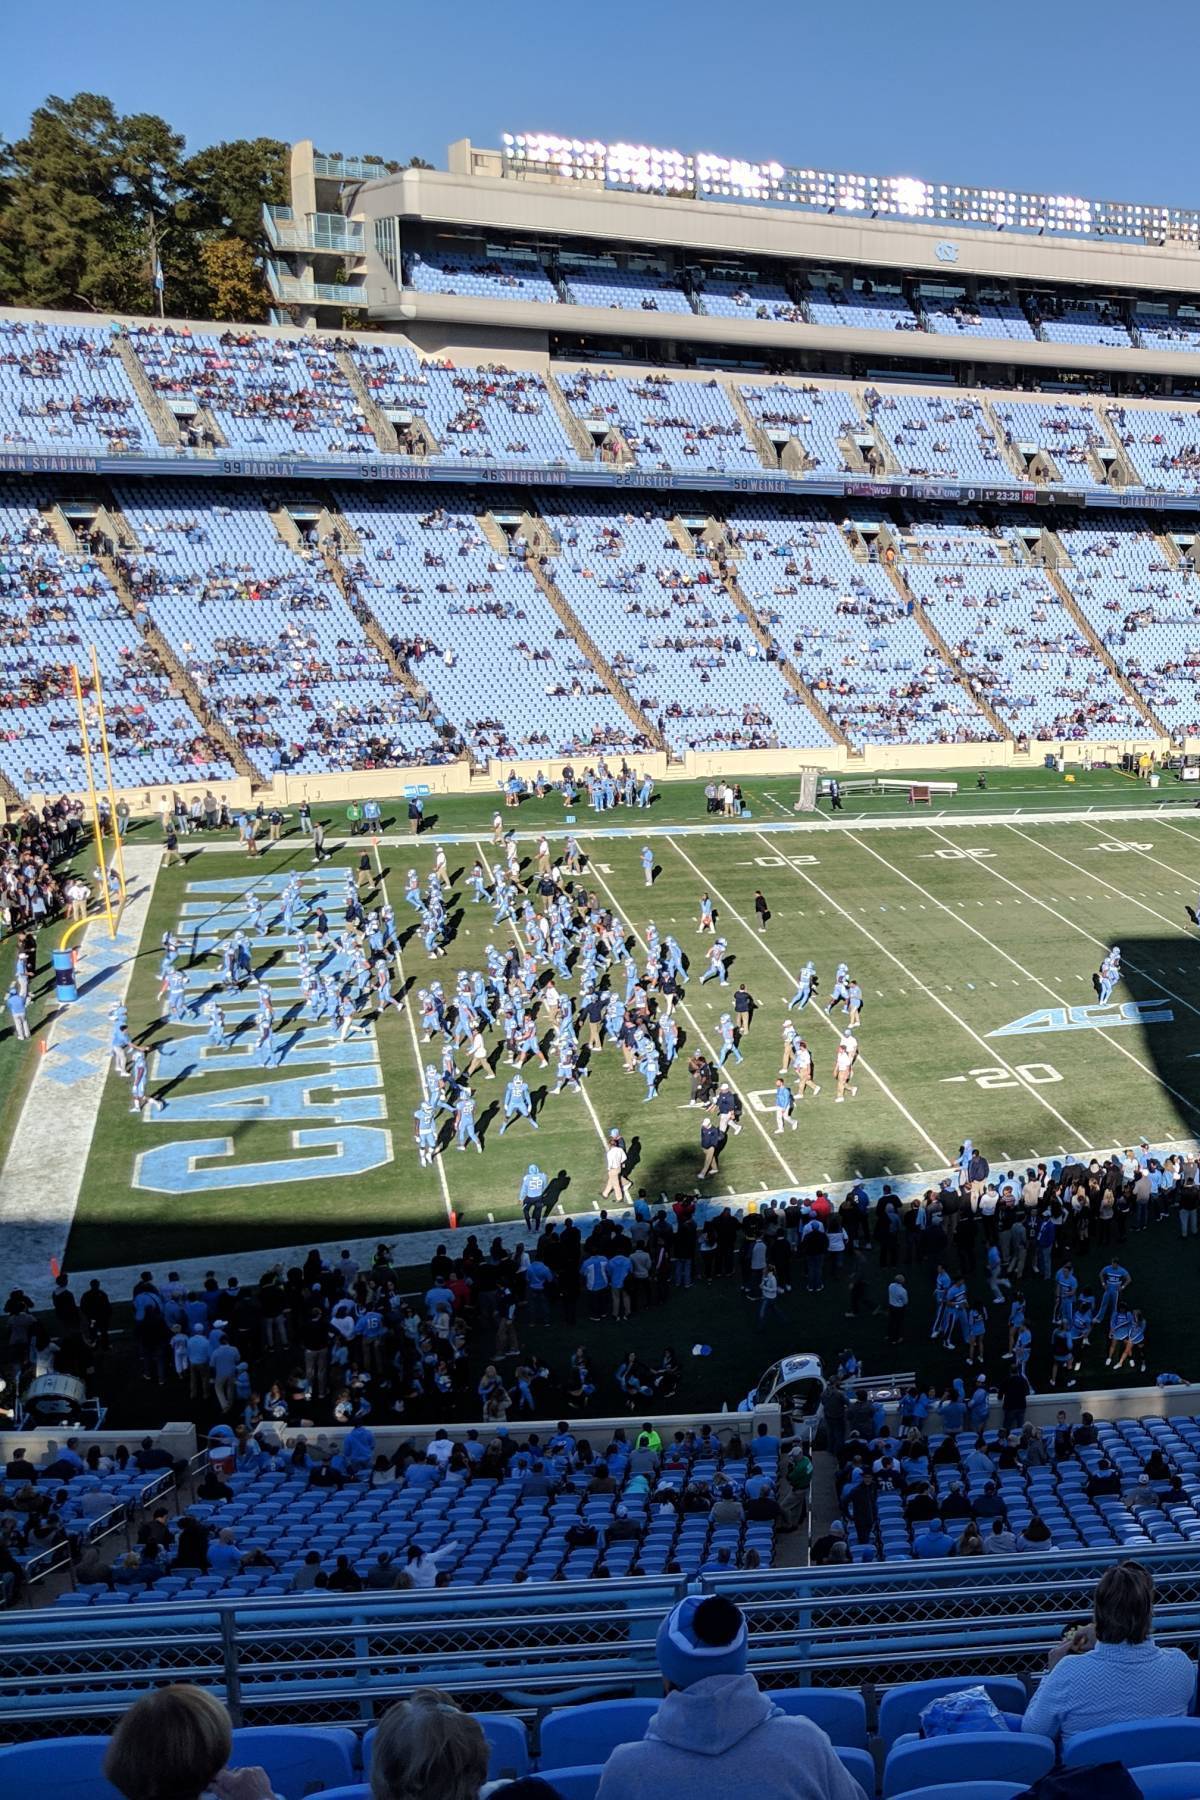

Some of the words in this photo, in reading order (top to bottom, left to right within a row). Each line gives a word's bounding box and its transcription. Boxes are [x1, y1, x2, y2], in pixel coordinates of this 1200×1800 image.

[33, 457, 97, 472] STADIUM
[223, 461, 242, 474] 99
[244, 462, 294, 476] BARCLAY
[361, 465, 378, 478] 59
[380, 467, 431, 481] BERSHAK
[482, 469, 498, 482] 46
[499, 470, 567, 484] SUTHERLAND
[616, 475, 631, 486] 22
[632, 475, 675, 488] JUSTICE
[734, 479, 748, 490] 50
[749, 480, 786, 492] WEINER
[873, 486, 892, 495] WCU
[900, 486, 908, 497] 0
[944, 487, 961, 498] UNC
[967, 488, 975, 500] 0
[996, 491, 1020, 501] 23:28
[934, 848, 998, 859] 30
[1098, 842, 1154, 852] 40
[755, 854, 821, 867] 20
[982, 999, 1174, 1038] ACC
[968, 1063, 1065, 1090] 20
